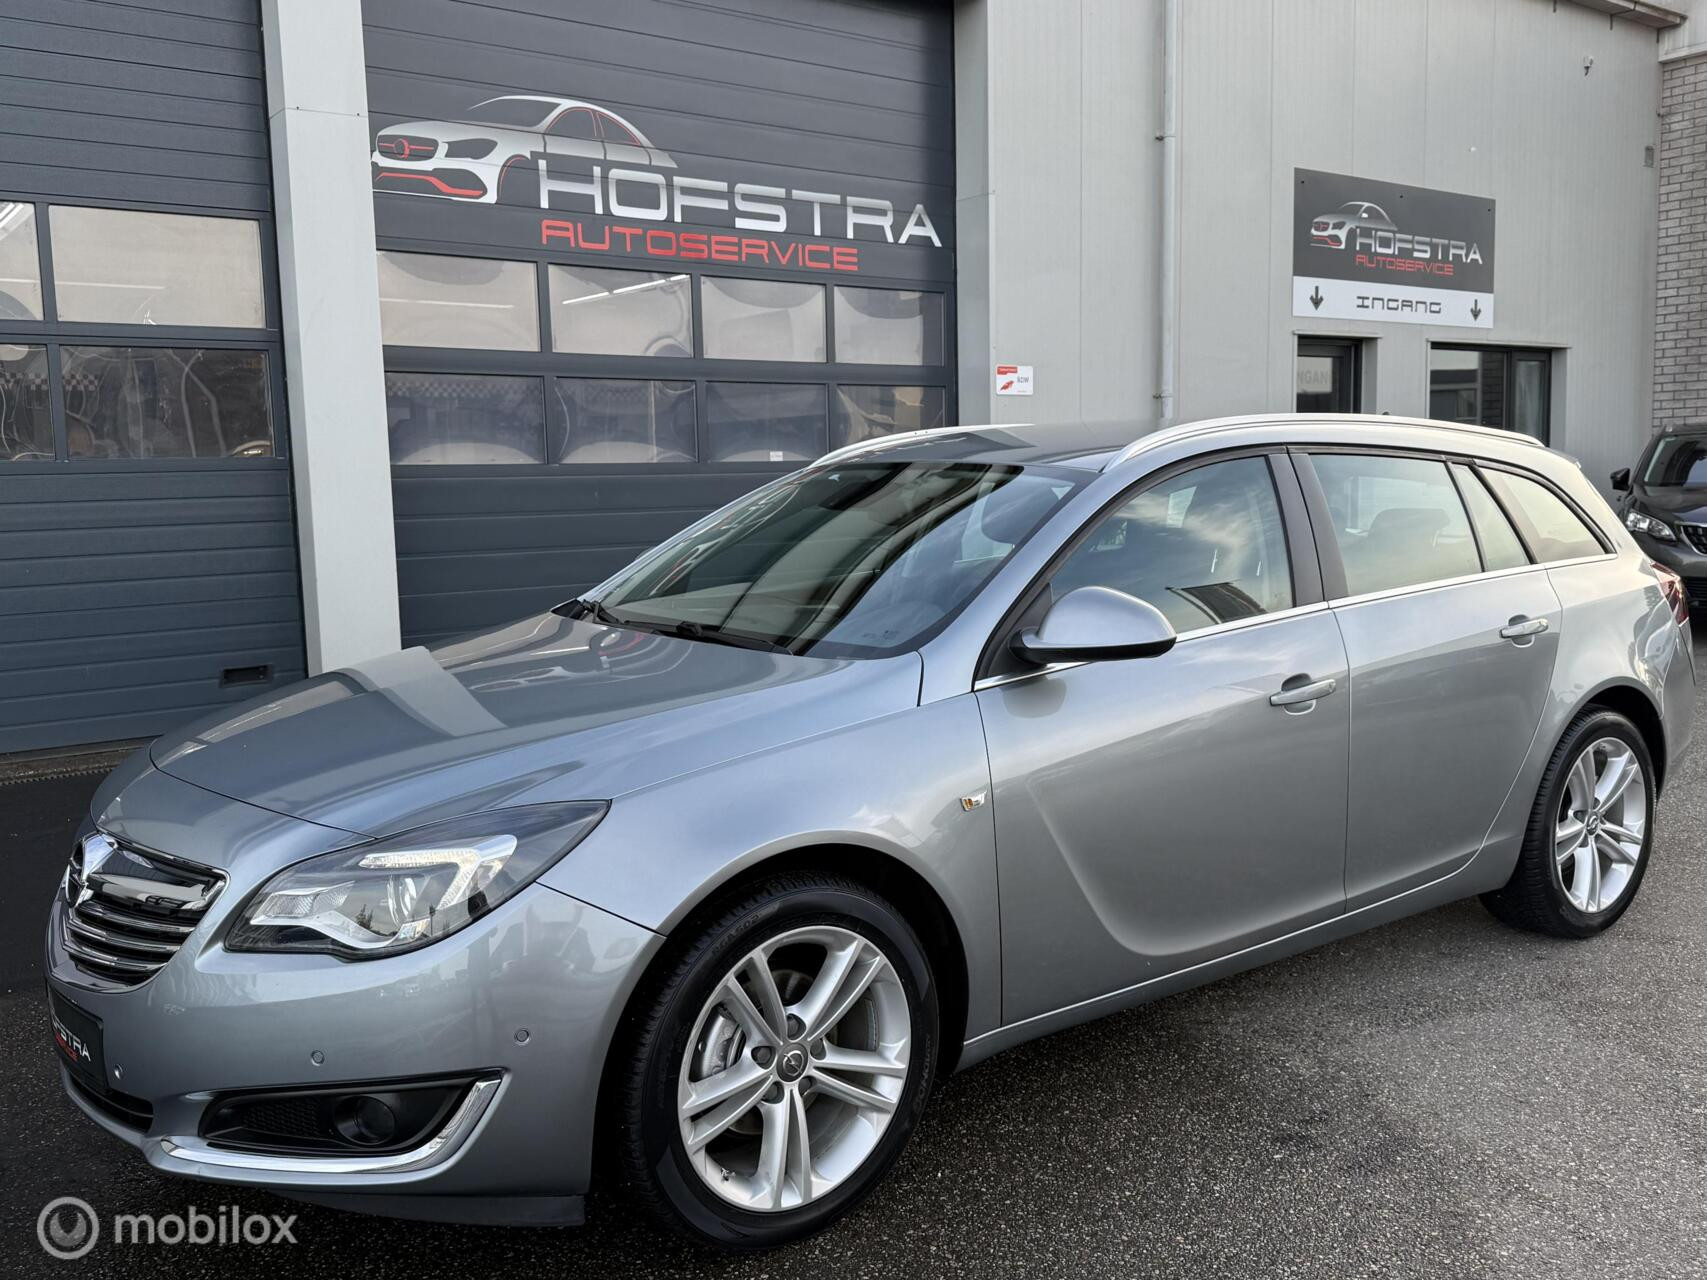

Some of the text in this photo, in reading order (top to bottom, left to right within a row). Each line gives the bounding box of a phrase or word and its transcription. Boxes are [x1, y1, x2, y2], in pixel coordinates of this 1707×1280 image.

[538, 159, 941, 247] HOFSTRA
[541, 219, 858, 271] AUTOSERVICE
[1356, 228, 1482, 264] HOFSTRA
[1355, 254, 1454, 275] AUTOSERVICE
[1356, 295, 1441, 314] INGANG
